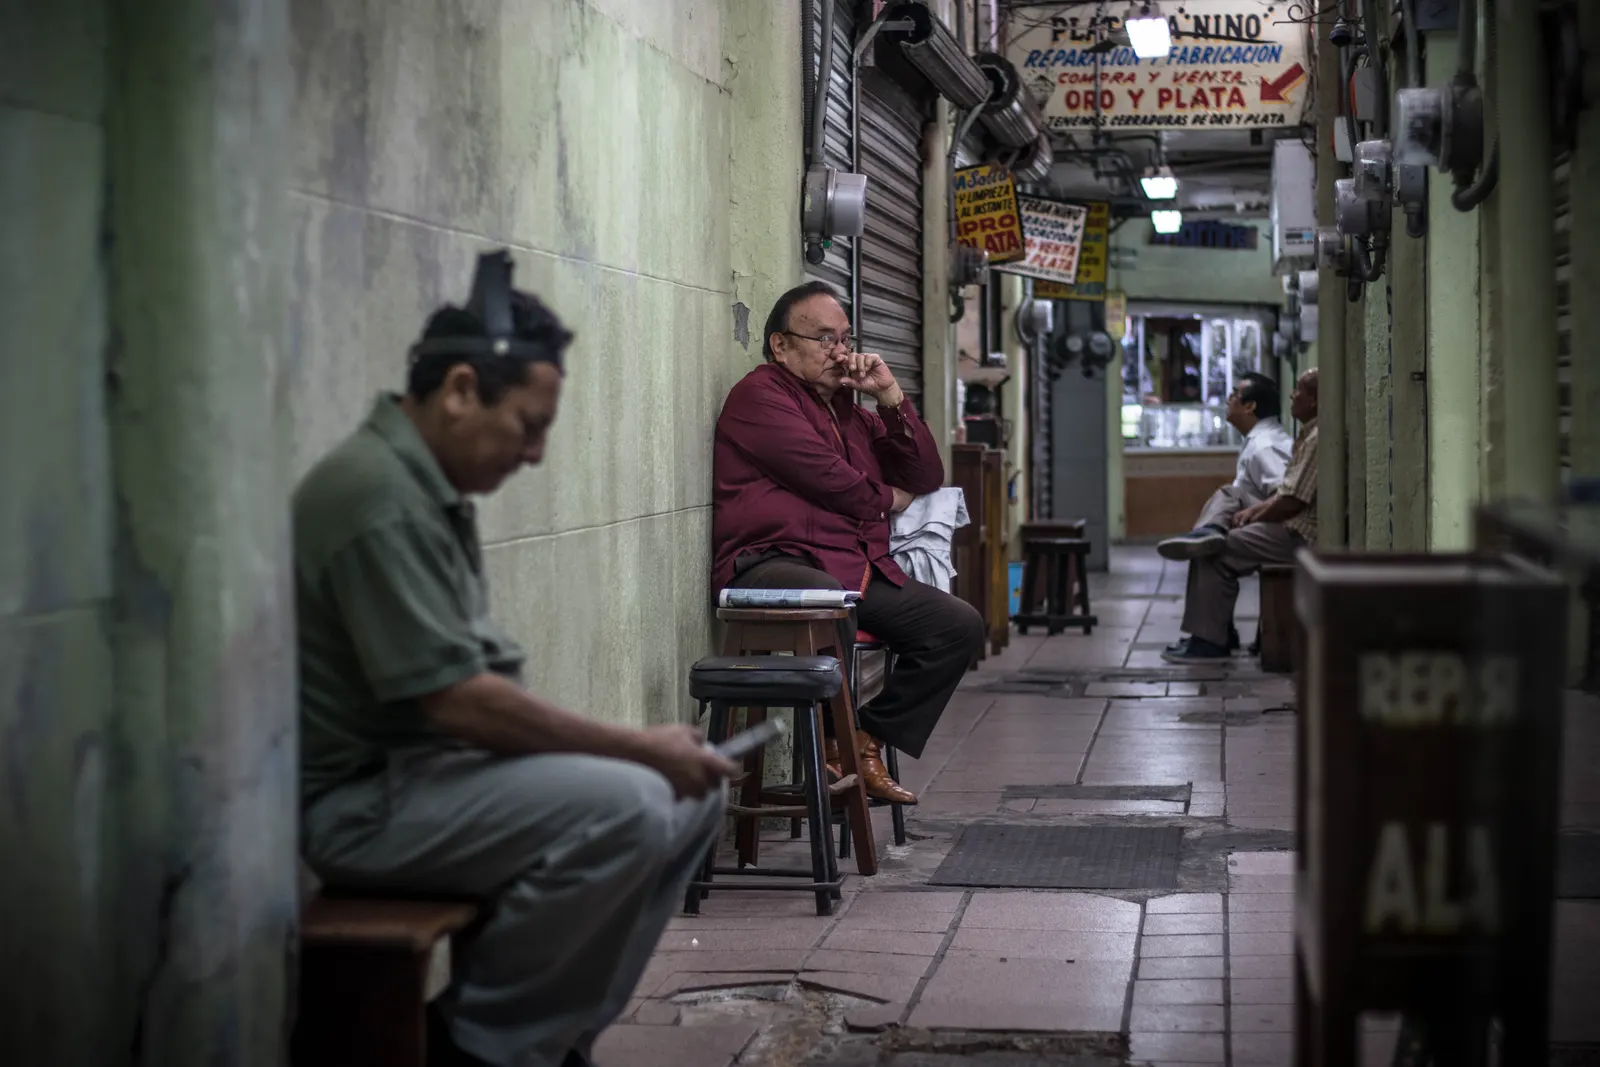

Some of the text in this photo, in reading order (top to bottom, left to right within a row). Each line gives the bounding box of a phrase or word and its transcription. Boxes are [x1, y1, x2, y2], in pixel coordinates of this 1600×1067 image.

[1051, 15, 1181, 41] PLATA
[1024, 48, 1140, 68] REPARACION
[1166, 45, 1283, 65] FABRICACION
[1058, 70, 1244, 84] COMPRA Y VENTA
[1065, 86, 1246, 110] ORO Y PLATA
[1243, 113, 1285, 125] PLATA
[967, 184, 1011, 204] LIMPIEZA
